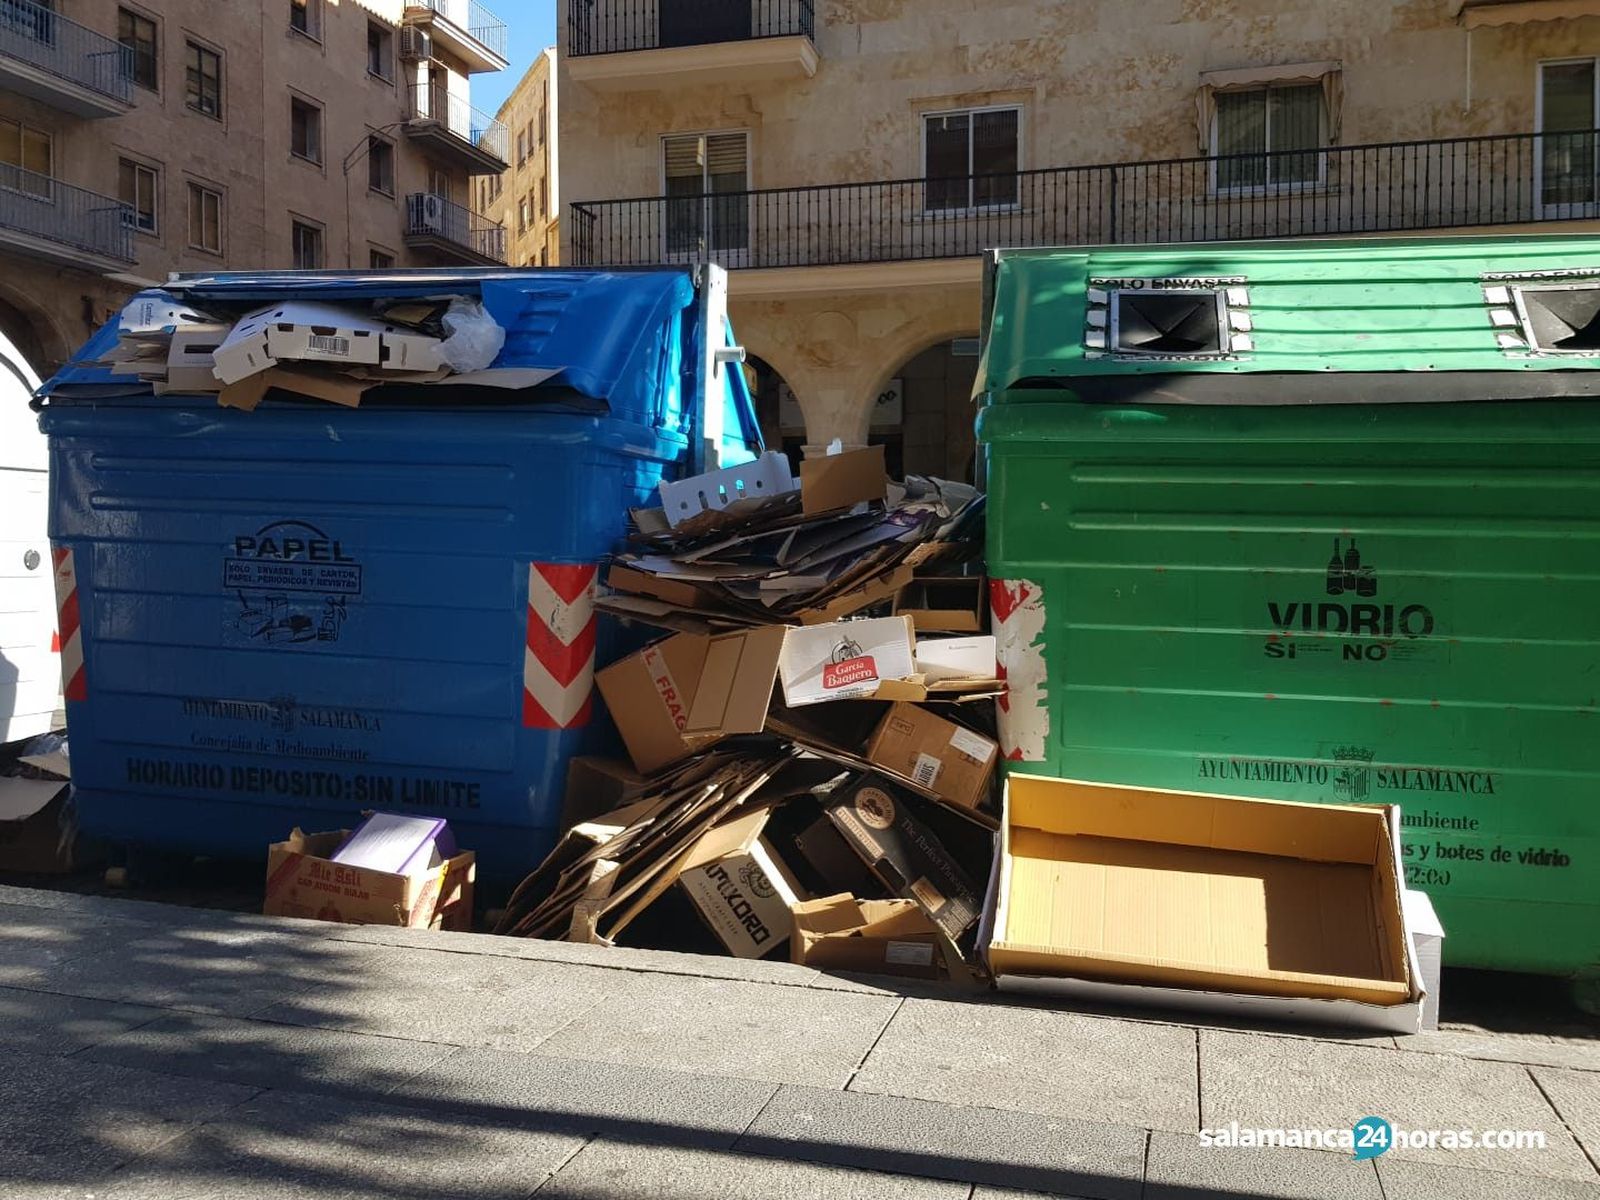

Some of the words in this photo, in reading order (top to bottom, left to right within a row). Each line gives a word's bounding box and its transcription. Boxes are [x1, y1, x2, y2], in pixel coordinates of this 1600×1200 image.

[1093, 277, 1145, 290] SOLO
[235, 535, 354, 562] PAPEL
[1267, 602, 1434, 638] VIDRIO
[1264, 642, 1296, 659] SI
[1343, 644, 1387, 661] NO
[826, 669, 873, 687] Baquero
[300, 710, 381, 732] SALAMANCA
[126, 757, 225, 790] HORARIO
[400, 776, 480, 808] LIMITE
[1198, 758, 1328, 786] AYUNTAMIENTO
[1377, 768, 1496, 795] SALAMANCA
[1419, 844, 1430, 861] y
[1436, 842, 1484, 861] botes
[1491, 845, 1511, 862] de
[1518, 847, 1570, 867] vidrio
[1404, 865, 1451, 886] 2:00
